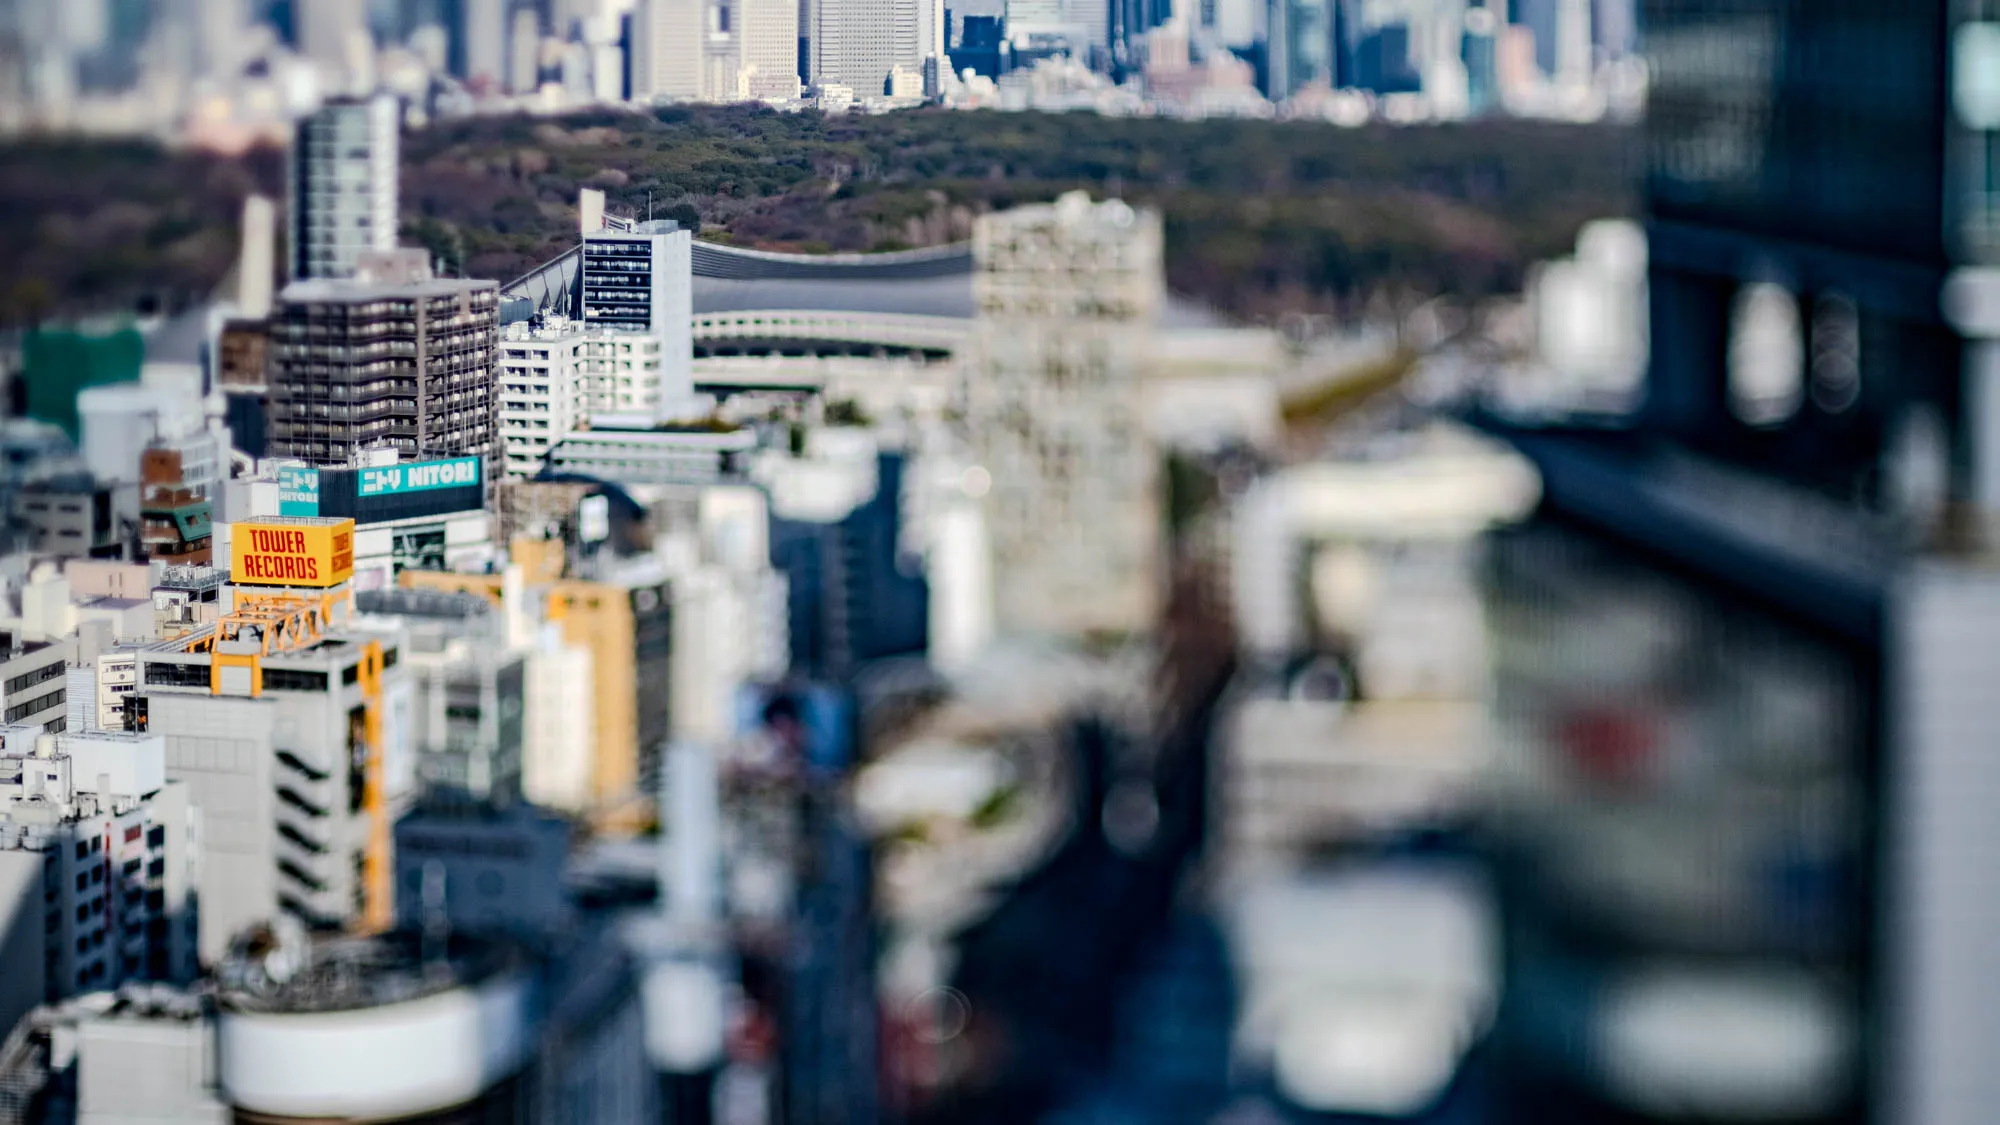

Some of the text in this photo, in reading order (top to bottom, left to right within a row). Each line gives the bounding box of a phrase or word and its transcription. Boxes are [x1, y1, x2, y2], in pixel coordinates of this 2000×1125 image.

[279, 471, 318, 490] ニトリ
[363, 461, 475, 493] ニトリ NITORI
[249, 529, 306, 554] TOWER
[243, 554, 318, 580] RECORDS
